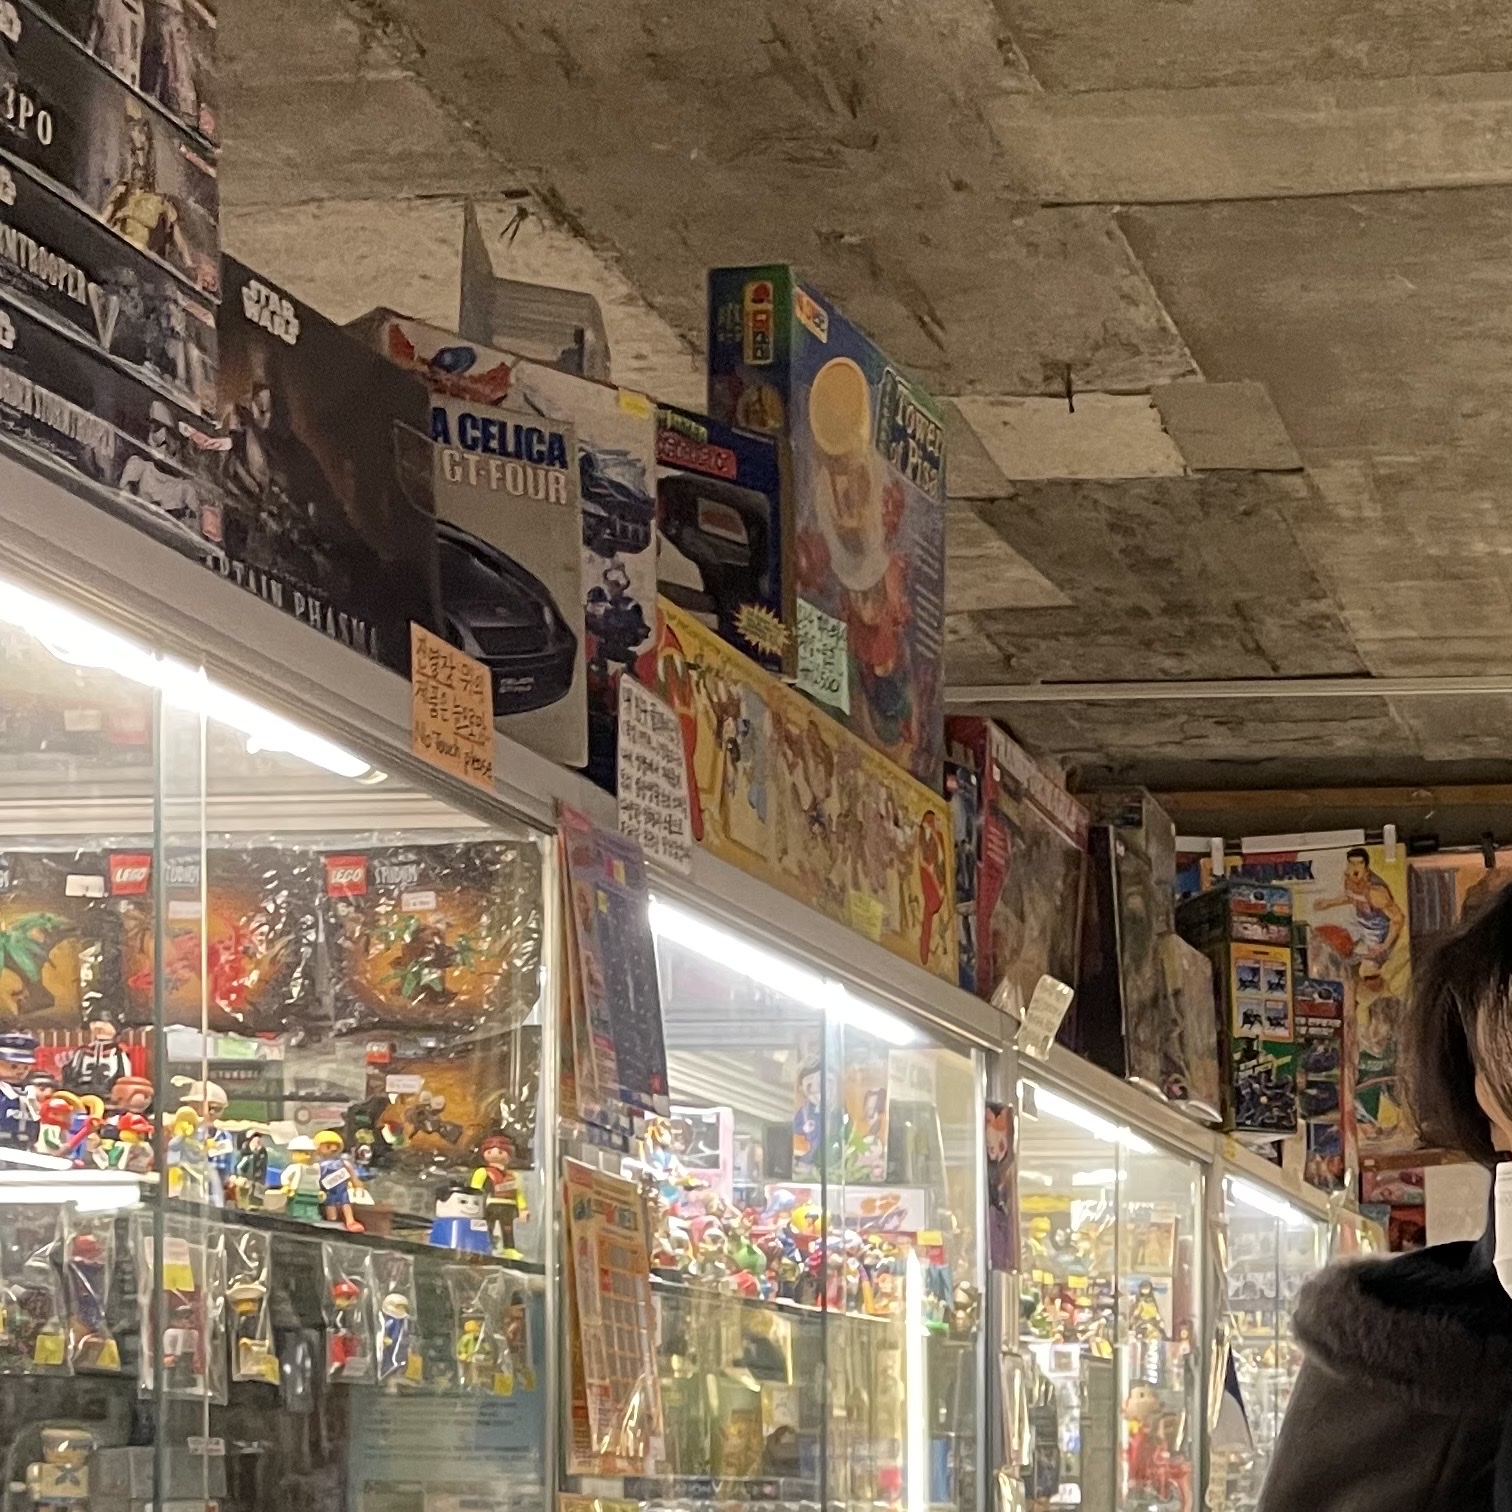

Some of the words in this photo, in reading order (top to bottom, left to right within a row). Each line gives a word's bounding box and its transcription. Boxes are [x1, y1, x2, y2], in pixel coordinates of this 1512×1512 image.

[241, 279, 297, 321] STAR
[245, 300, 300, 346] WARS
[458, 412, 568, 468] CELICA
[443, 450, 567, 504] GT-FOUR
[114, 867, 147, 882] LEGO
[330, 866, 362, 883] LEGO
